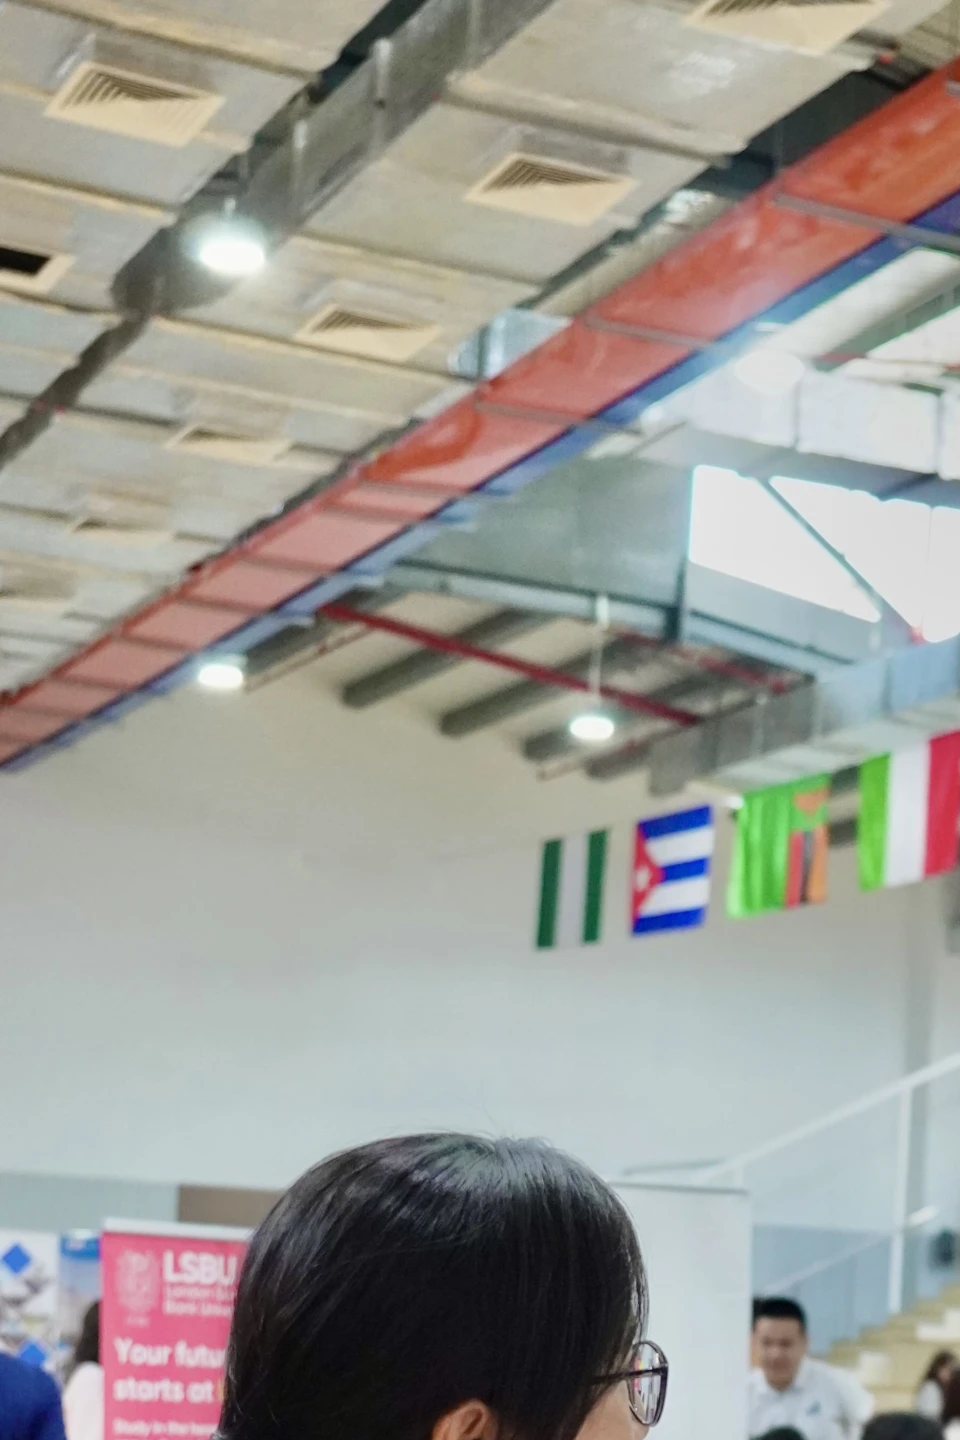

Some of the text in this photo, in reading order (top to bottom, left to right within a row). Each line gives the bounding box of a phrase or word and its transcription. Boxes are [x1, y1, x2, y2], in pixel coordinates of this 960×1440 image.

[163, 1249, 236, 1286] LSBU
[113, 1336, 171, 1367] Your
[113, 1376, 215, 1404] starts at
